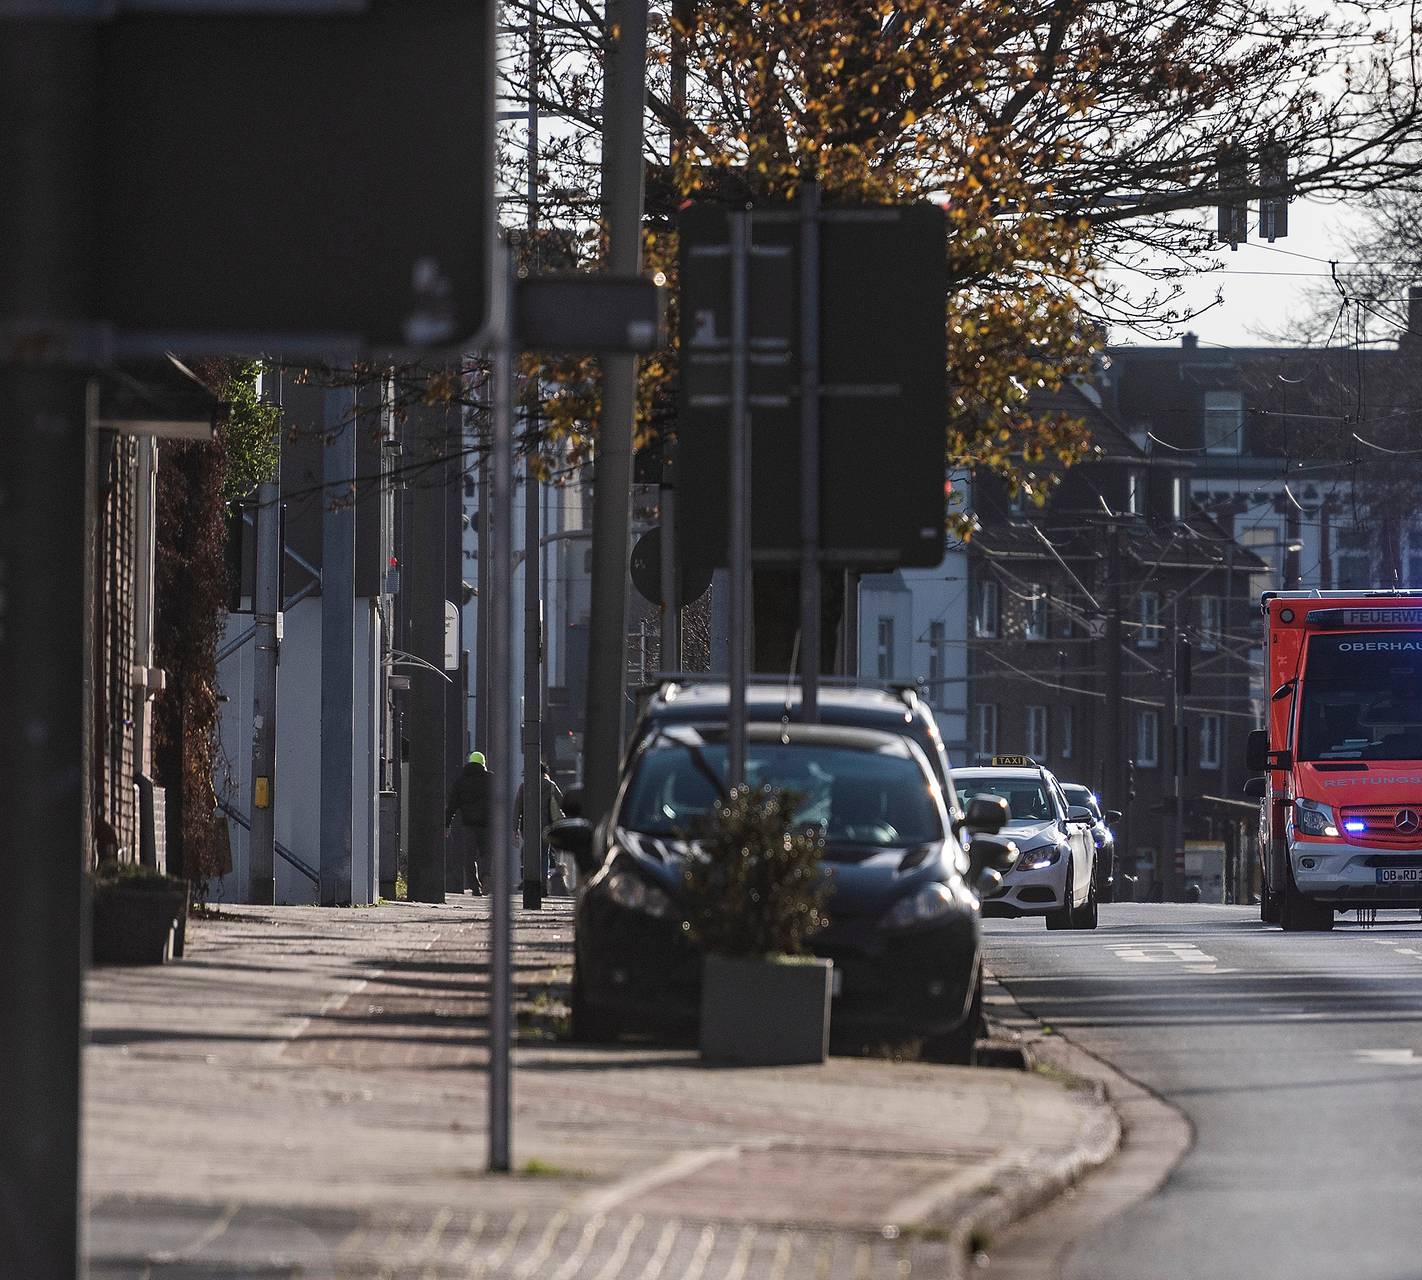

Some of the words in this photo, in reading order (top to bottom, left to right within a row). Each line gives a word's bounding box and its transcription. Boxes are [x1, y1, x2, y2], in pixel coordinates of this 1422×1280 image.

[999, 757, 1022, 765] TAXI
[1383, 869, 1397, 881] OB
[1403, 869, 1417, 881] RD
